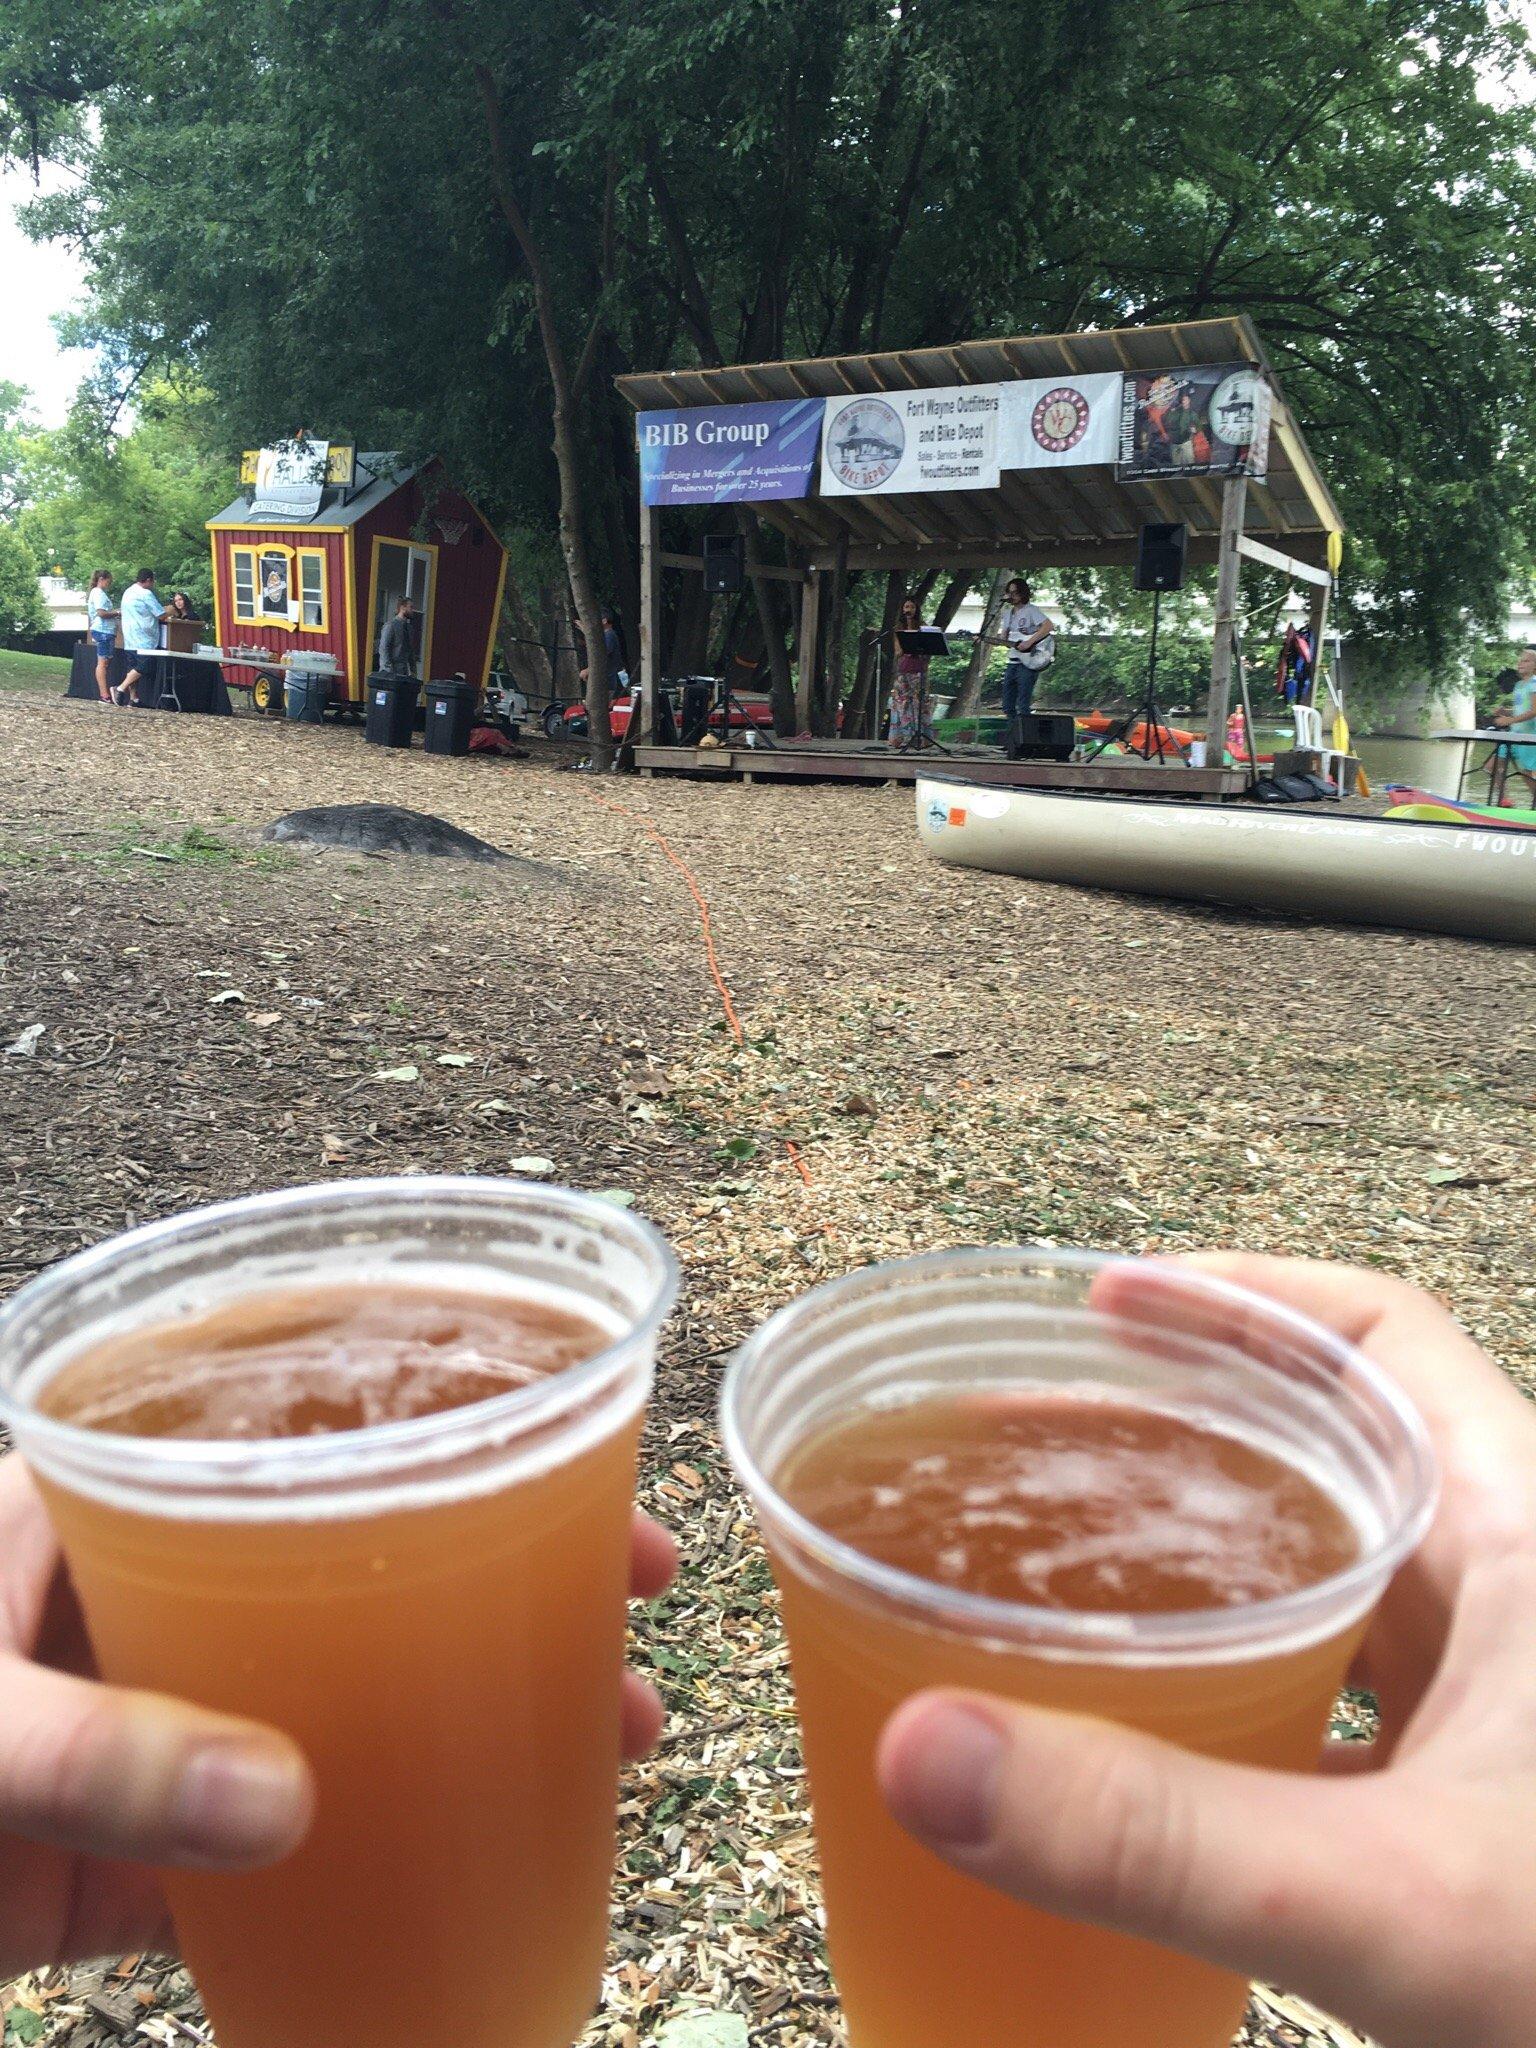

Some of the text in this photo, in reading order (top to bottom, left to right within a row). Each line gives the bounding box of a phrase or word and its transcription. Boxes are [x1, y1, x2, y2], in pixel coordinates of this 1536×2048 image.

[907, 400, 924, 417] Fort
[926, 399, 955, 419] Wayne
[957, 395, 999, 414] Outfitters
[645, 420, 770, 447] BIB Group
[919, 423, 984, 443] and Bike Depot
[961, 448, 984, 459] Rentals
[703, 469, 735, 479] Mergers
[737, 467, 753, 477] and
[863, 462, 890, 484] DEPOT
[750, 480, 759, 488] 25
